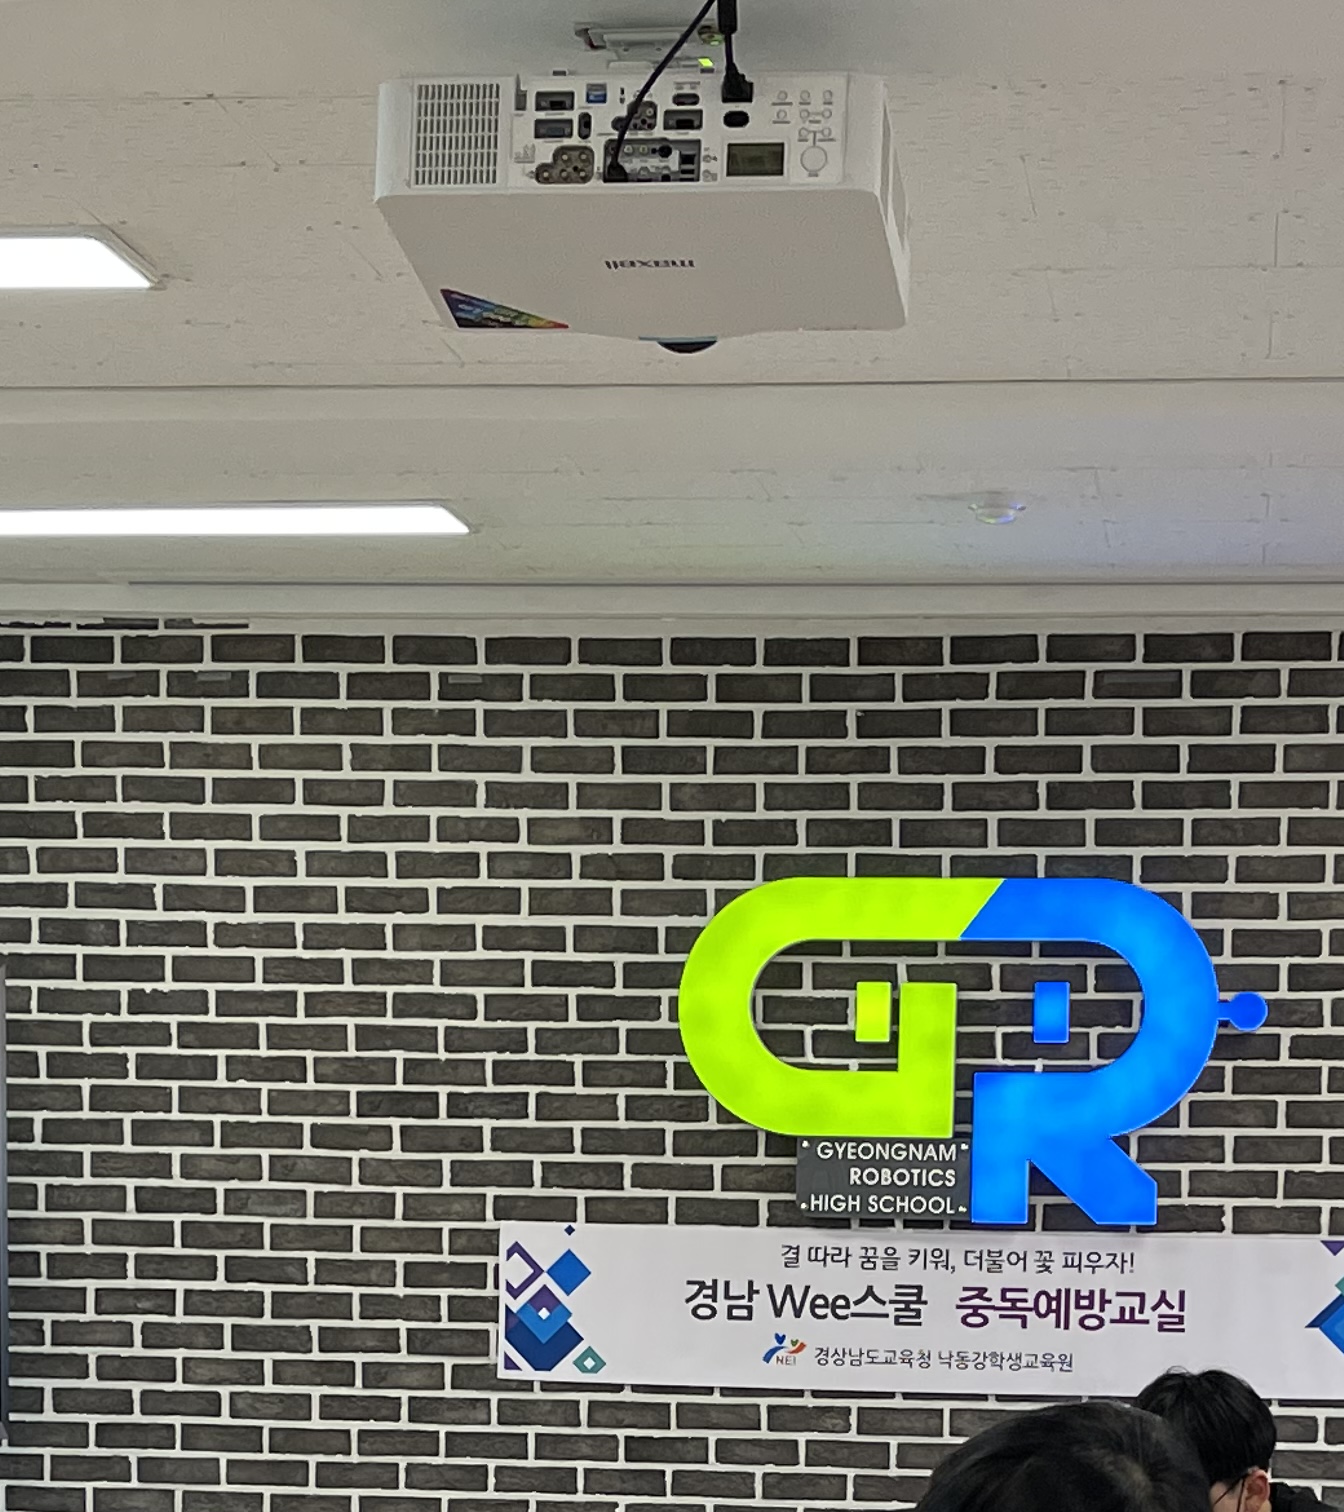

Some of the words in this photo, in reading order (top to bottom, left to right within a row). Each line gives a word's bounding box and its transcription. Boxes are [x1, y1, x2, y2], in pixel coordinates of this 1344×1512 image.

[816, 1141, 957, 1163] GYEONGNAM
[849, 1167, 956, 1187] ROBOTICS
[810, 1193, 861, 1213] HIGH
[867, 1195, 955, 1215] SCHOOL
[781, 1243, 800, 1269] 결
[807, 1245, 852, 1269] 따라
[858, 1246, 902, 1272] 꿈을
[907, 1247, 956, 1275] 키워,
[963, 1248, 1028, 1274] 더불어
[1033, 1250, 1055, 1275] 꽃
[1061, 1251, 1136, 1275] 피우자!
[684, 1278, 760, 1321] 경남
[766, 1284, 929, 1327] Wee스쿨
[955, 1286, 1186, 1334] 중독예방교실
[814, 1346, 932, 1369] 경상남도교육청
[937, 1350, 1074, 1373] 낙동강학생교육원
